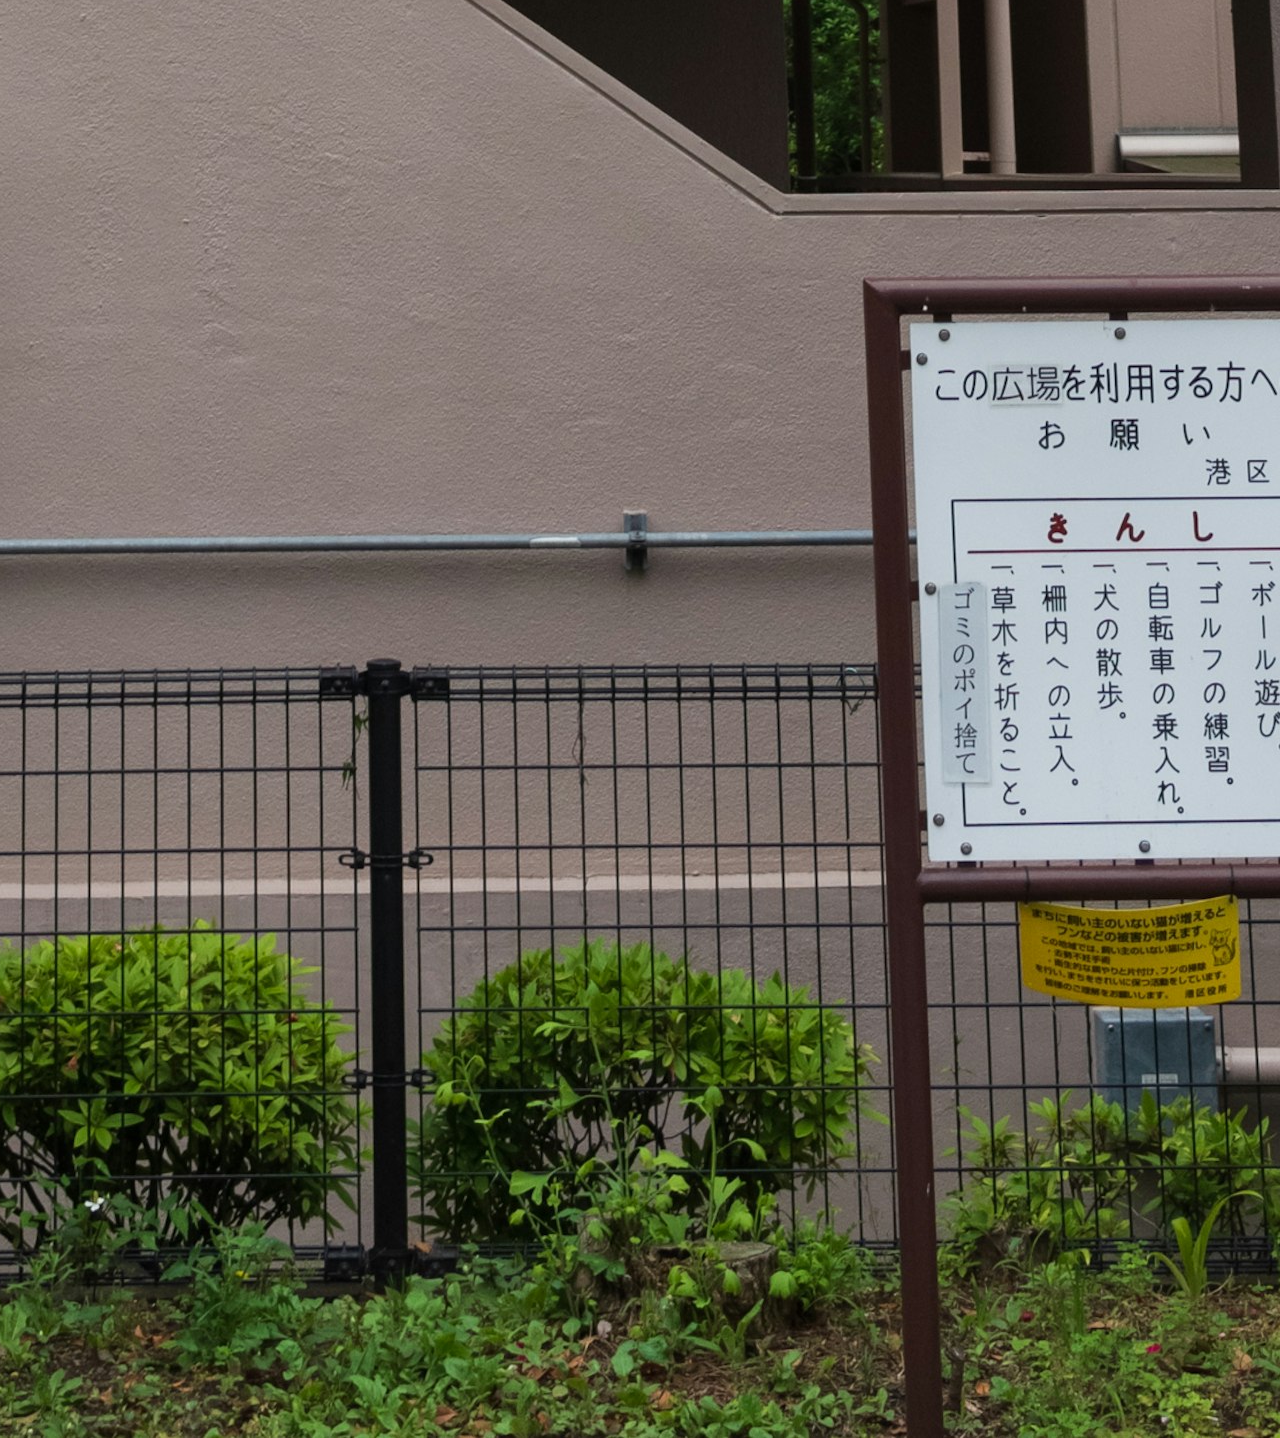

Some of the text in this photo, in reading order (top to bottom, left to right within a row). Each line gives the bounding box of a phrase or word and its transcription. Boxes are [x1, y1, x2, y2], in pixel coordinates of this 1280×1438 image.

[1205, 458, 1270, 485] 港区
[953, 587, 978, 774] ゴミのポイ捨て
